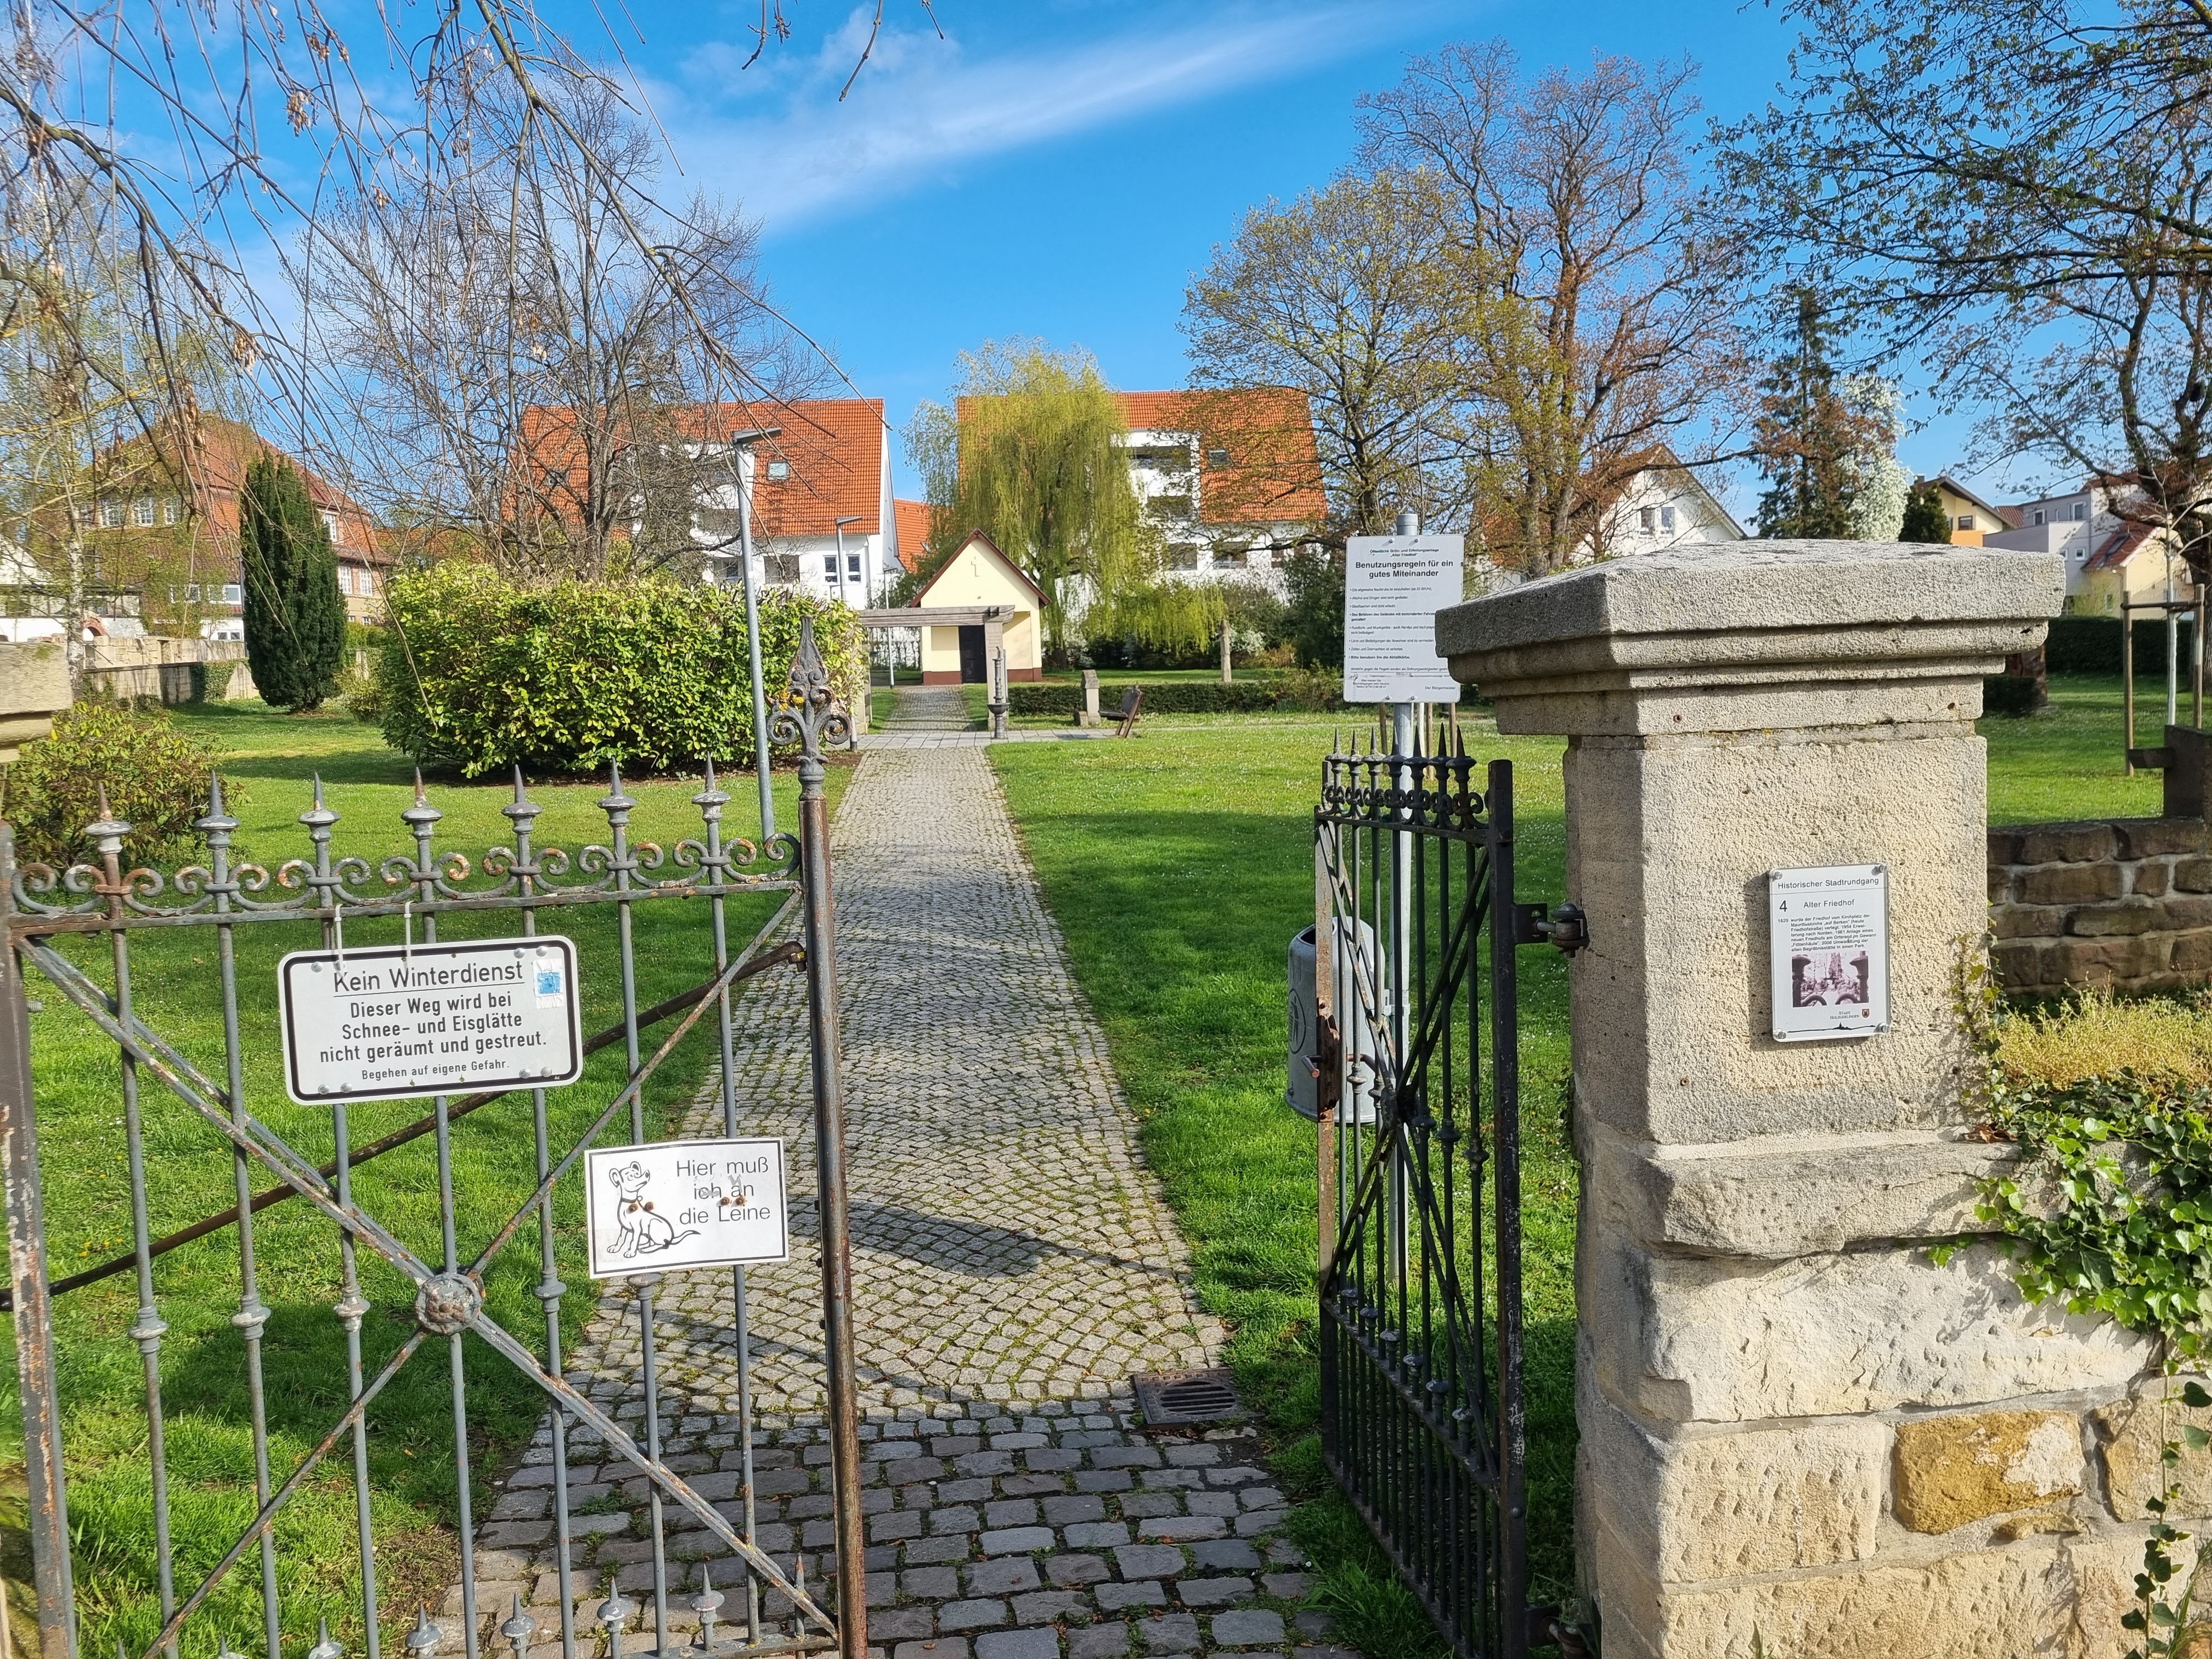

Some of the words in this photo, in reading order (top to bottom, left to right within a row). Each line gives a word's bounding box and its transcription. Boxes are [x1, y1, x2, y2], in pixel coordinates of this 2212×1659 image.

[1356, 561, 1426, 569] Benutzungsregeln
[1369, 571, 1391, 579] gutes
[1778, 881, 1822, 889] Historischer
[1825, 878, 1879, 887] Stadtrundgang
[1779, 900, 1788, 912] 4
[1824, 899, 1855, 907] Friedhof
[333, 970, 380, 992] Kein
[388, 961, 523, 988] Winterdienst
[350, 1001, 401, 1018] Dieser
[407, 997, 440, 1017] Weg
[447, 992, 482, 1011] wird
[488, 991, 512, 1008] bei
[342, 1023, 410, 1040] Schnee-
[417, 1019, 446, 1034] und
[453, 1013, 523, 1034] Eisglätte
[320, 1045, 360, 1063] nicht
[367, 1040, 434, 1063] geräumt
[441, 1036, 469, 1053] und
[475, 1030, 547, 1054] gestreut.
[362, 1068, 407, 1081] Begehen
[411, 1065, 428, 1076] auf
[432, 1063, 467, 1076] eigene
[471, 1058, 510, 1071] Gefahr.
[676, 1159, 716, 1177] Hier
[727, 1156, 769, 1174] muß
[693, 1182, 722, 1200] ich
[731, 1183, 754, 1198] an
[679, 1207, 709, 1224] die
[718, 1205, 771, 1222] Leine
